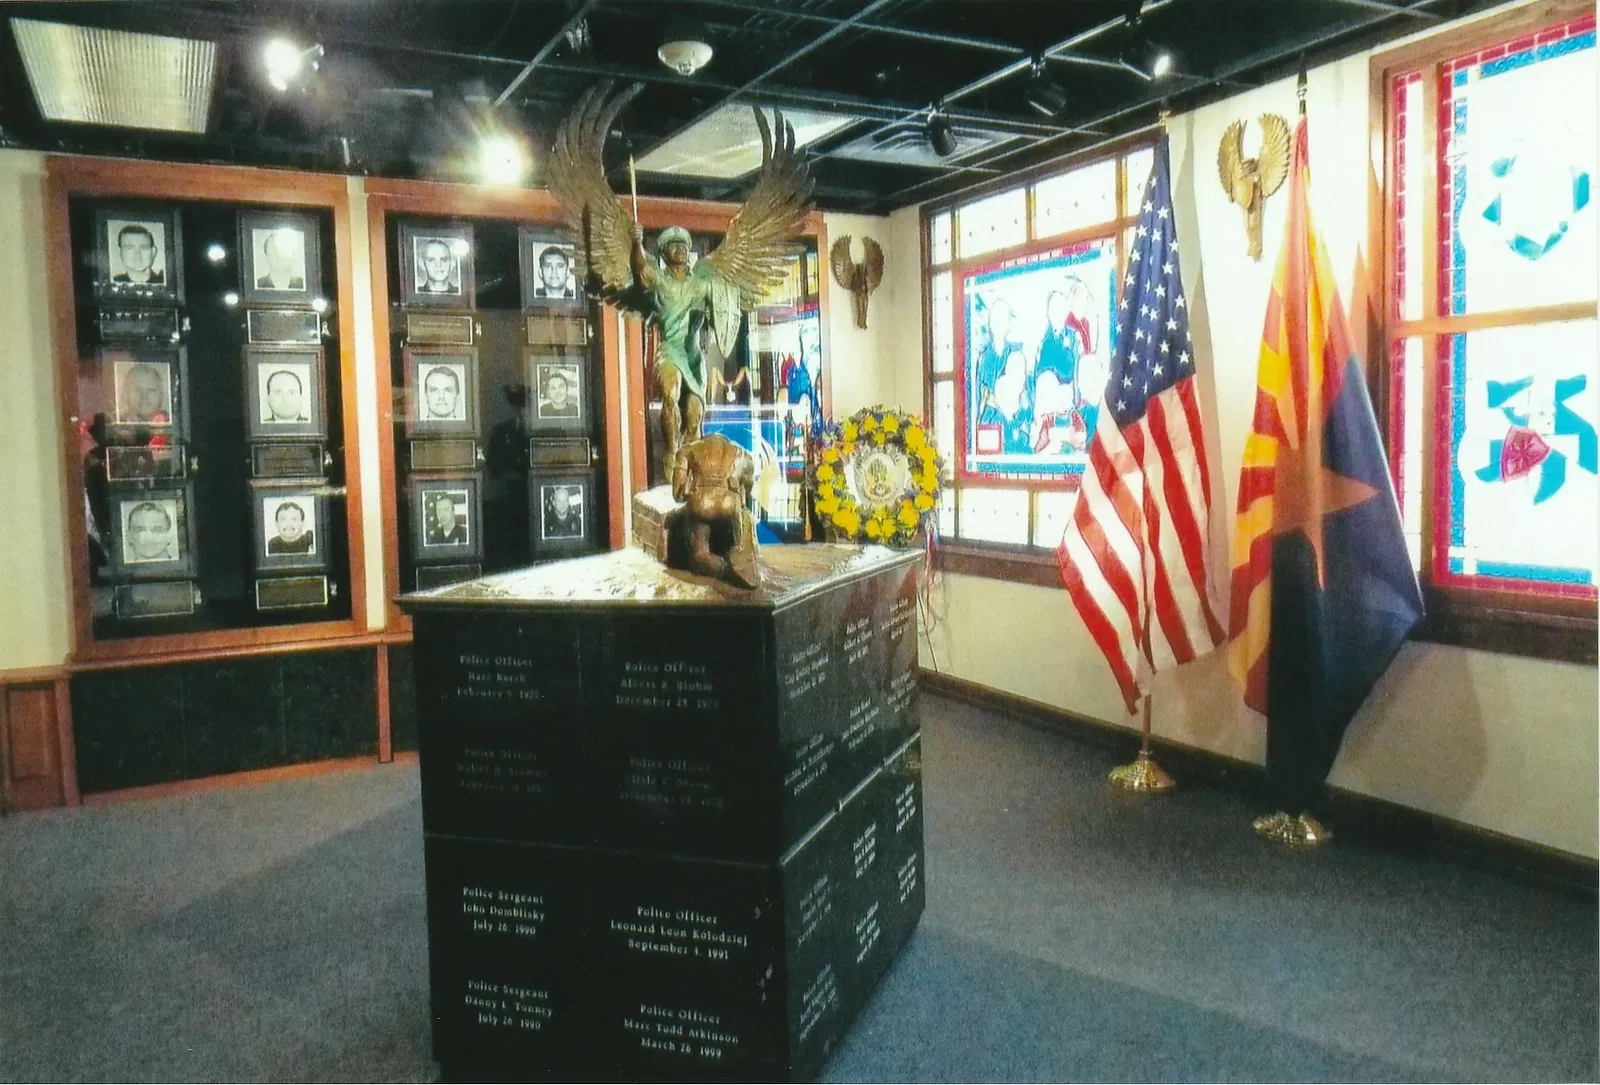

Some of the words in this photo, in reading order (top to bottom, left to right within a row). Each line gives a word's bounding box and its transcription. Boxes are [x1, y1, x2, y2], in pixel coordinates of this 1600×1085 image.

[459, 653, 490, 665] Police
[494, 655, 532, 668] Officer
[624, 660, 659, 673] Police
[664, 660, 706, 674] Officer
[615, 694, 670, 708] December
[629, 755, 663, 769] Police
[667, 758, 711, 772] Officer
[462, 886, 493, 899] Police
[497, 890, 544, 904] Sergeant
[463, 902, 485, 913] John
[489, 905, 544, 922] Domblisky
[637, 905, 671, 920] Police
[676, 908, 718, 925] Officer
[473, 919, 493, 932] July
[515, 924, 536, 936] 1990
[610, 919, 655, 935] Leonard
[660, 925, 687, 938] Leon
[628, 938, 688, 955] September
[708, 948, 729, 961] 1991
[468, 979, 499, 993] Police
[502, 984, 549, 999] Sergeant
[464, 994, 497, 1010] Danny
[478, 1012, 498, 1026] July
[520, 1018, 541, 1030] 1990
[640, 1003, 674, 1018] Police
[678, 1009, 720, 1025] Officer
[623, 1017, 650, 1031] Marc
[655, 1023, 683, 1036] Todd
[688, 1028, 739, 1044] Atkinson
[641, 1036, 675, 1051] March
[700, 1046, 722, 1059] 1999
